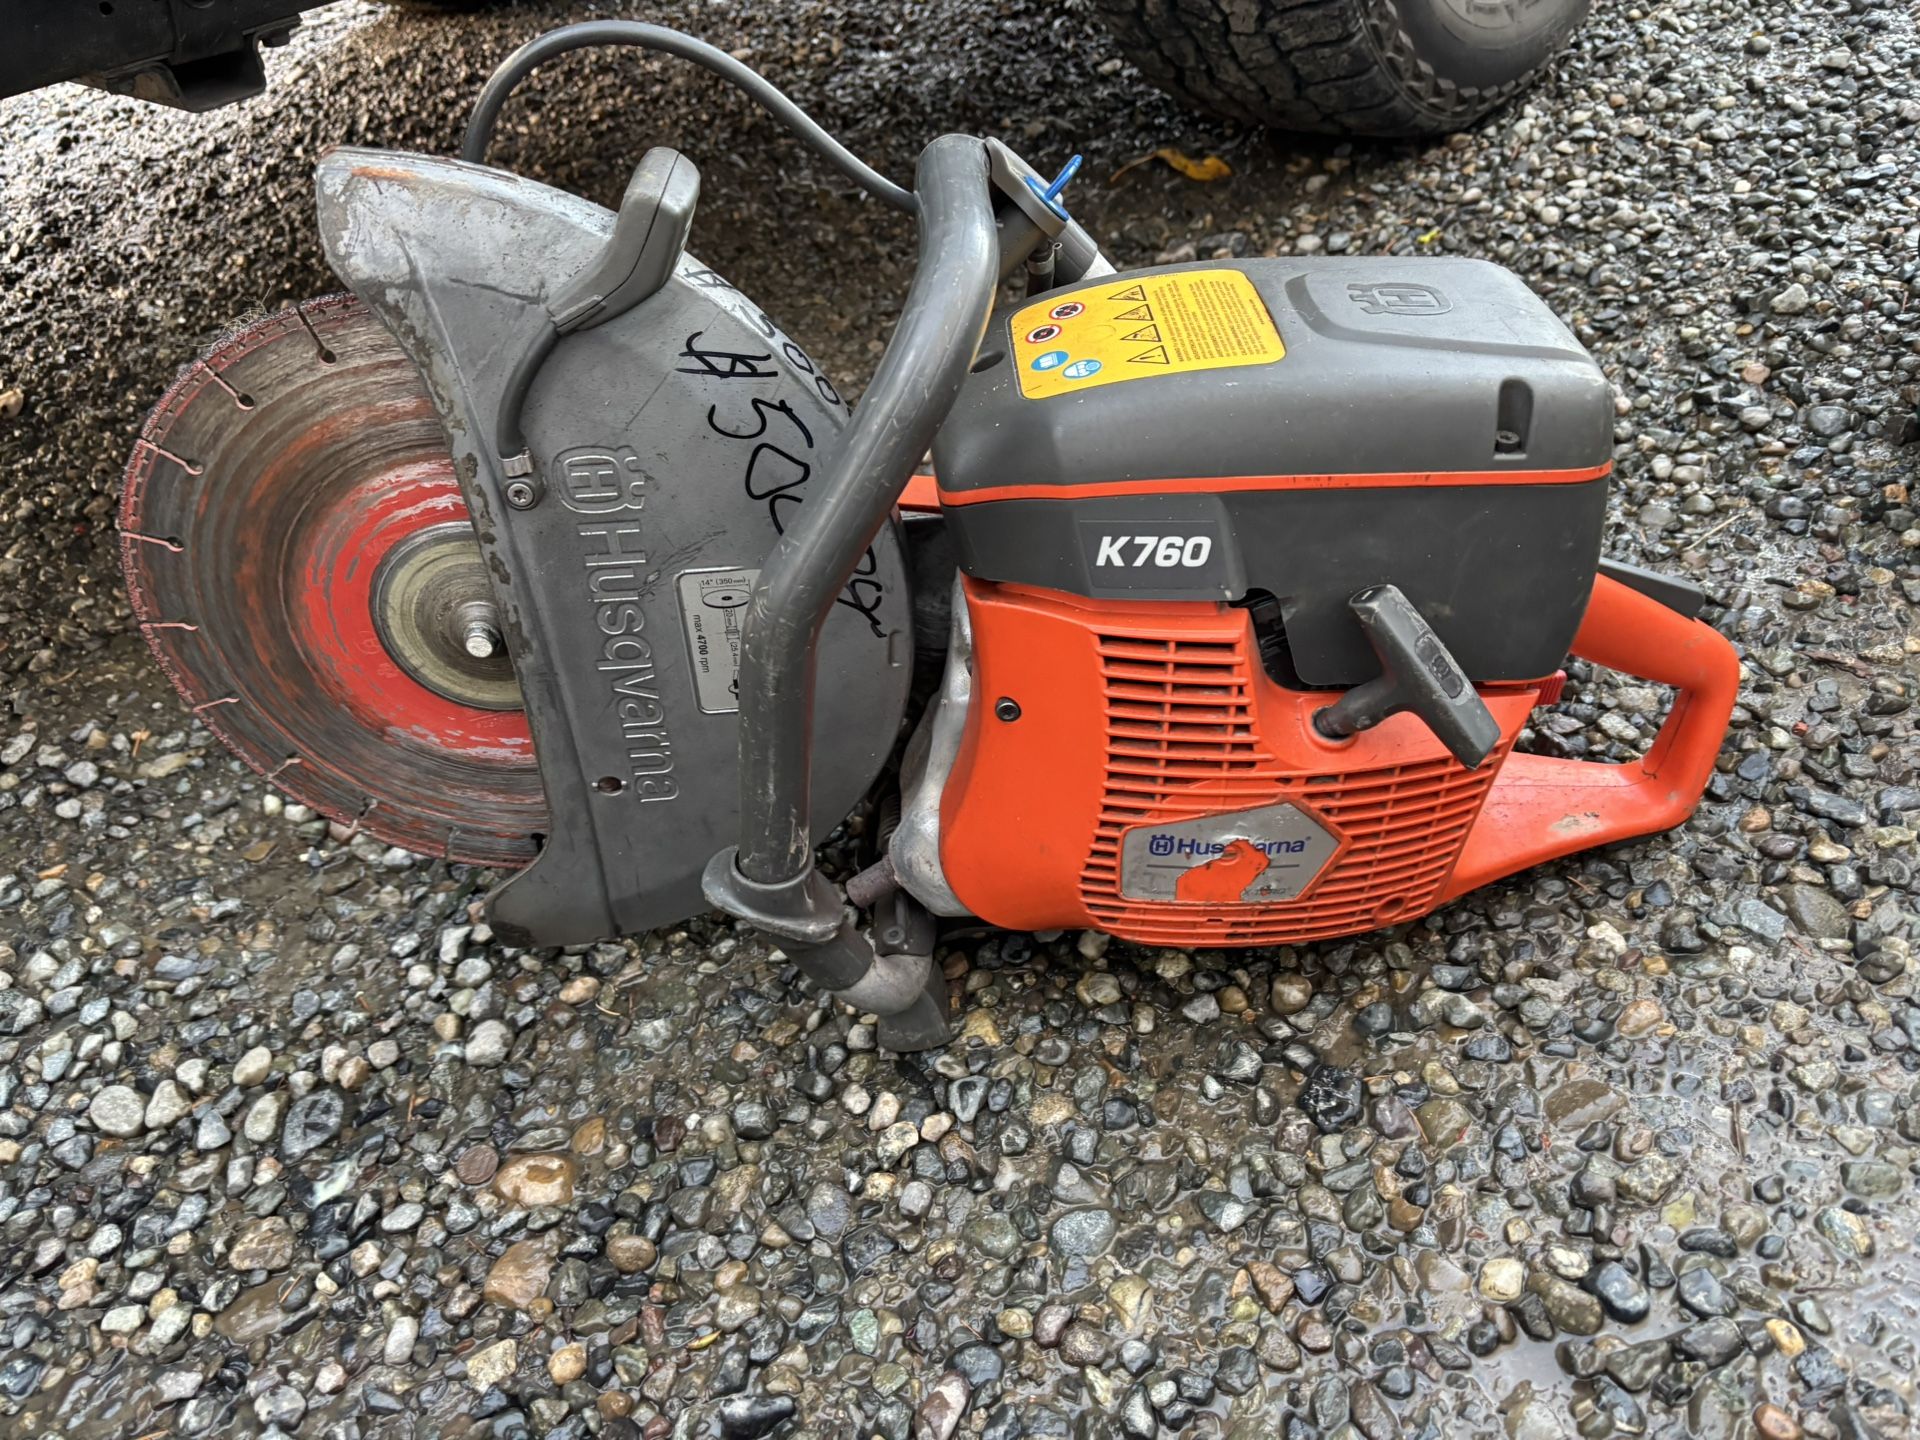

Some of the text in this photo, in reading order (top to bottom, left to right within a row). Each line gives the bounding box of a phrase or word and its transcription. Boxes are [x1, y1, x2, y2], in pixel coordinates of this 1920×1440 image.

[577, 518, 680, 804] Husqvarna
[693, 614, 710, 673] max 4700 rpm
[1177, 838, 1306, 856] Husarna
